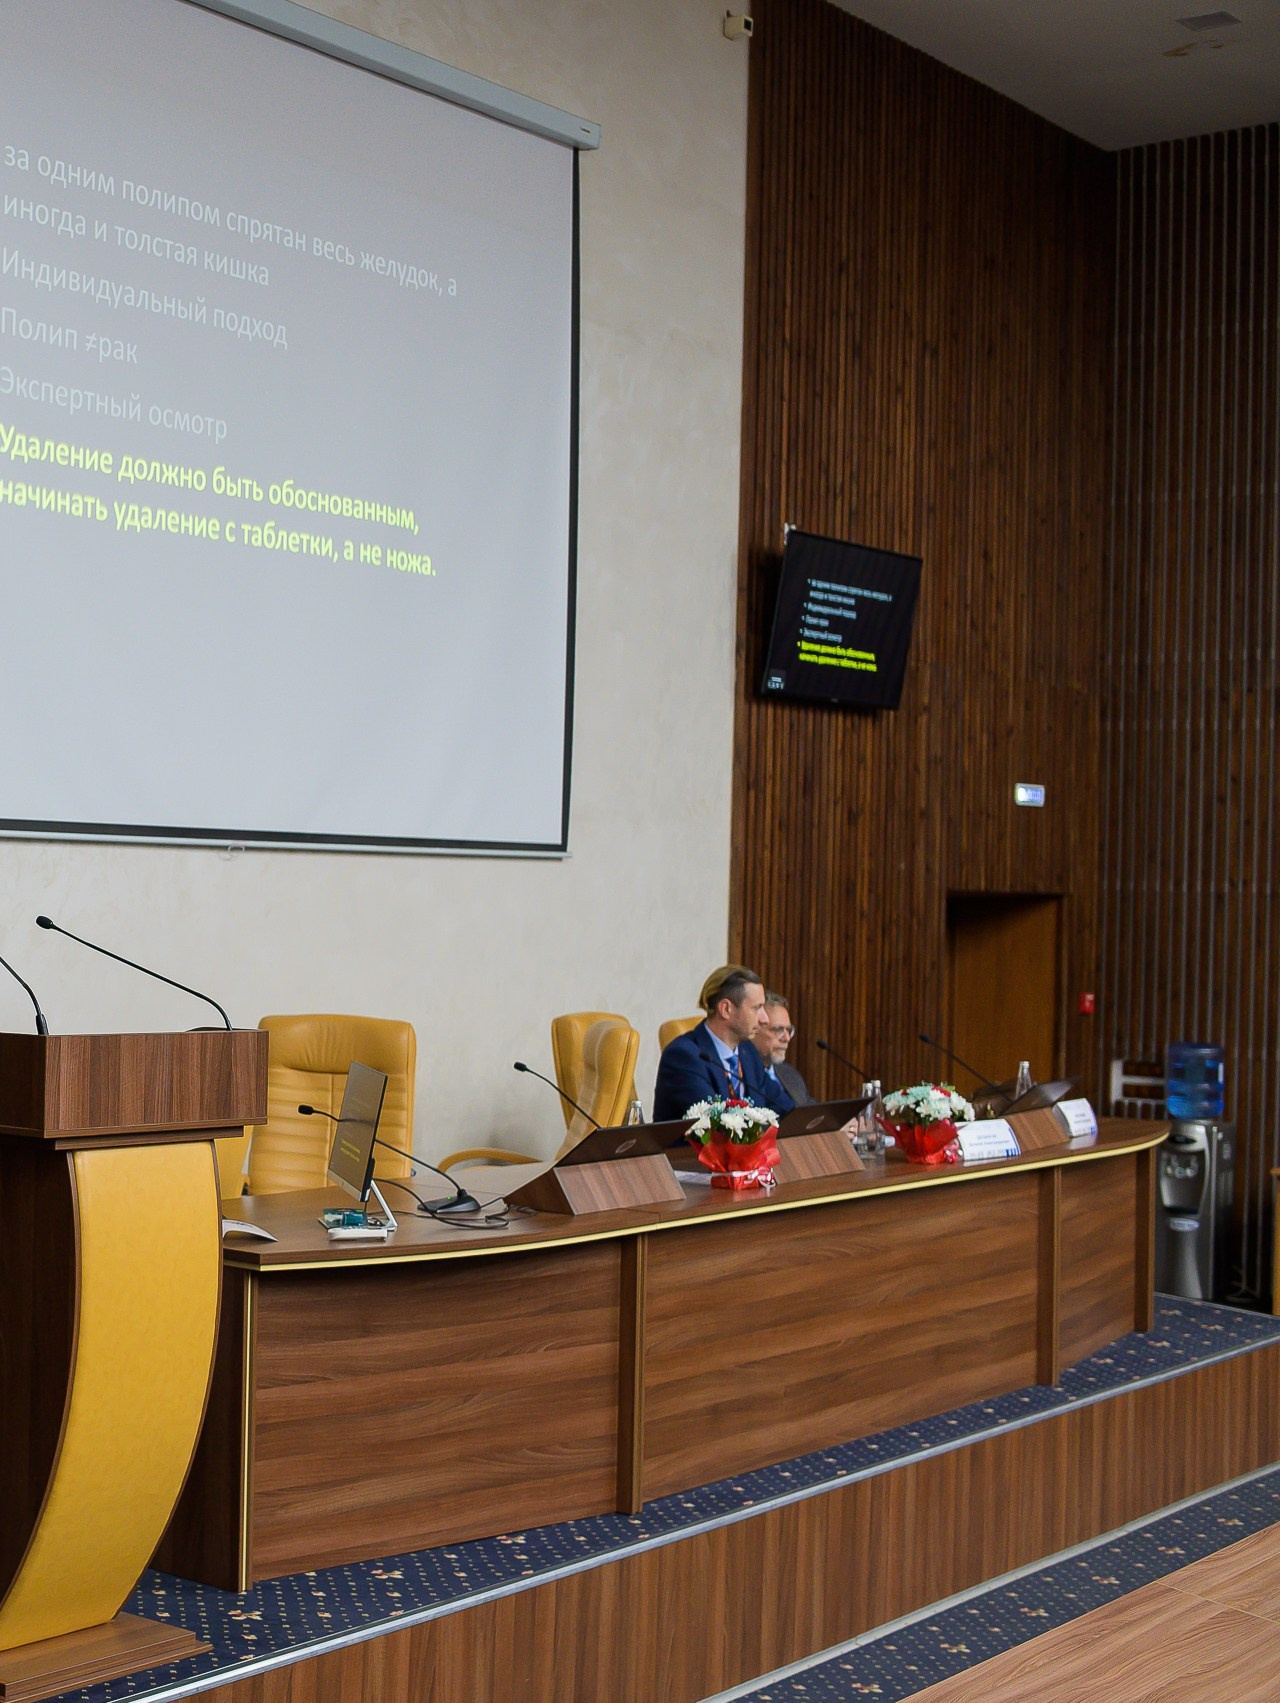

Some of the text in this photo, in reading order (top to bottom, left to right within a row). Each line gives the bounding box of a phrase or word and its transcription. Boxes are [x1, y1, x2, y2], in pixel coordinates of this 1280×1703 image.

[4, 145, 458, 297] за одним полипом спрятан весь желудок, а
[4, 195, 269, 286] иногда и толстая кишка
[1, 307, 77, 352] Полип
[2, 247, 288, 350] Индивидуальный подход
[0, 366, 228, 444] Экспертный осмотр
[118, 455, 207, 492] должно
[212, 466, 263, 501] быть
[269, 479, 420, 536] обоснованным,
[113, 500, 220, 541] удаление
[225, 520, 236, 543] с
[241, 520, 338, 563] таблетки,
[343, 540, 354, 562] а
[360, 542, 382, 566] не
[387, 550, 436, 577] ножа.
